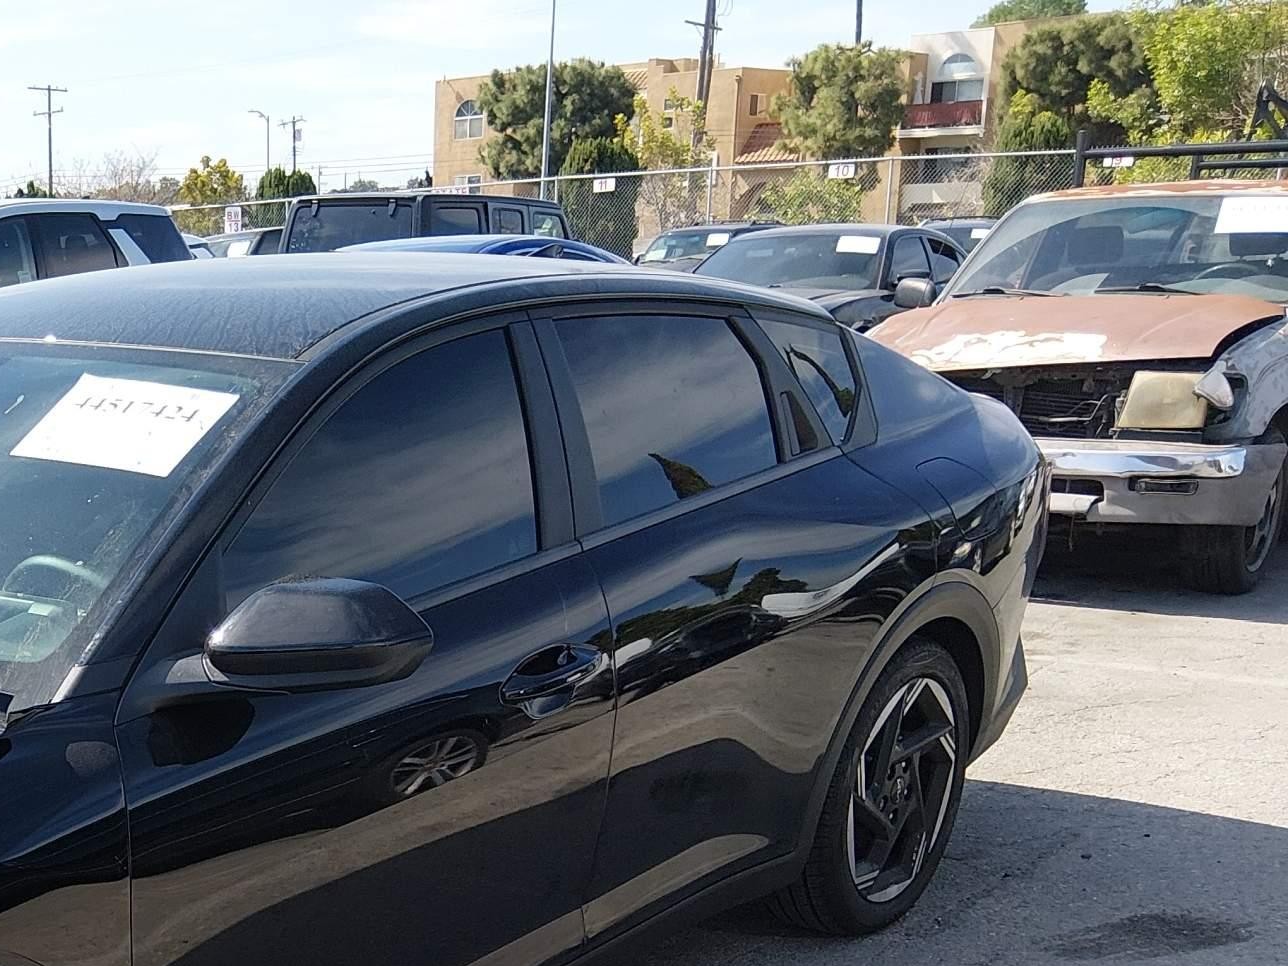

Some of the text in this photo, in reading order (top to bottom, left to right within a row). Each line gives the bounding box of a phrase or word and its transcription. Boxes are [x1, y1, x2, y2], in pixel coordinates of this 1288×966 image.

[834, 165, 849, 177] 10
[598, 179, 608, 191] 11
[228, 222, 240, 233] 13
